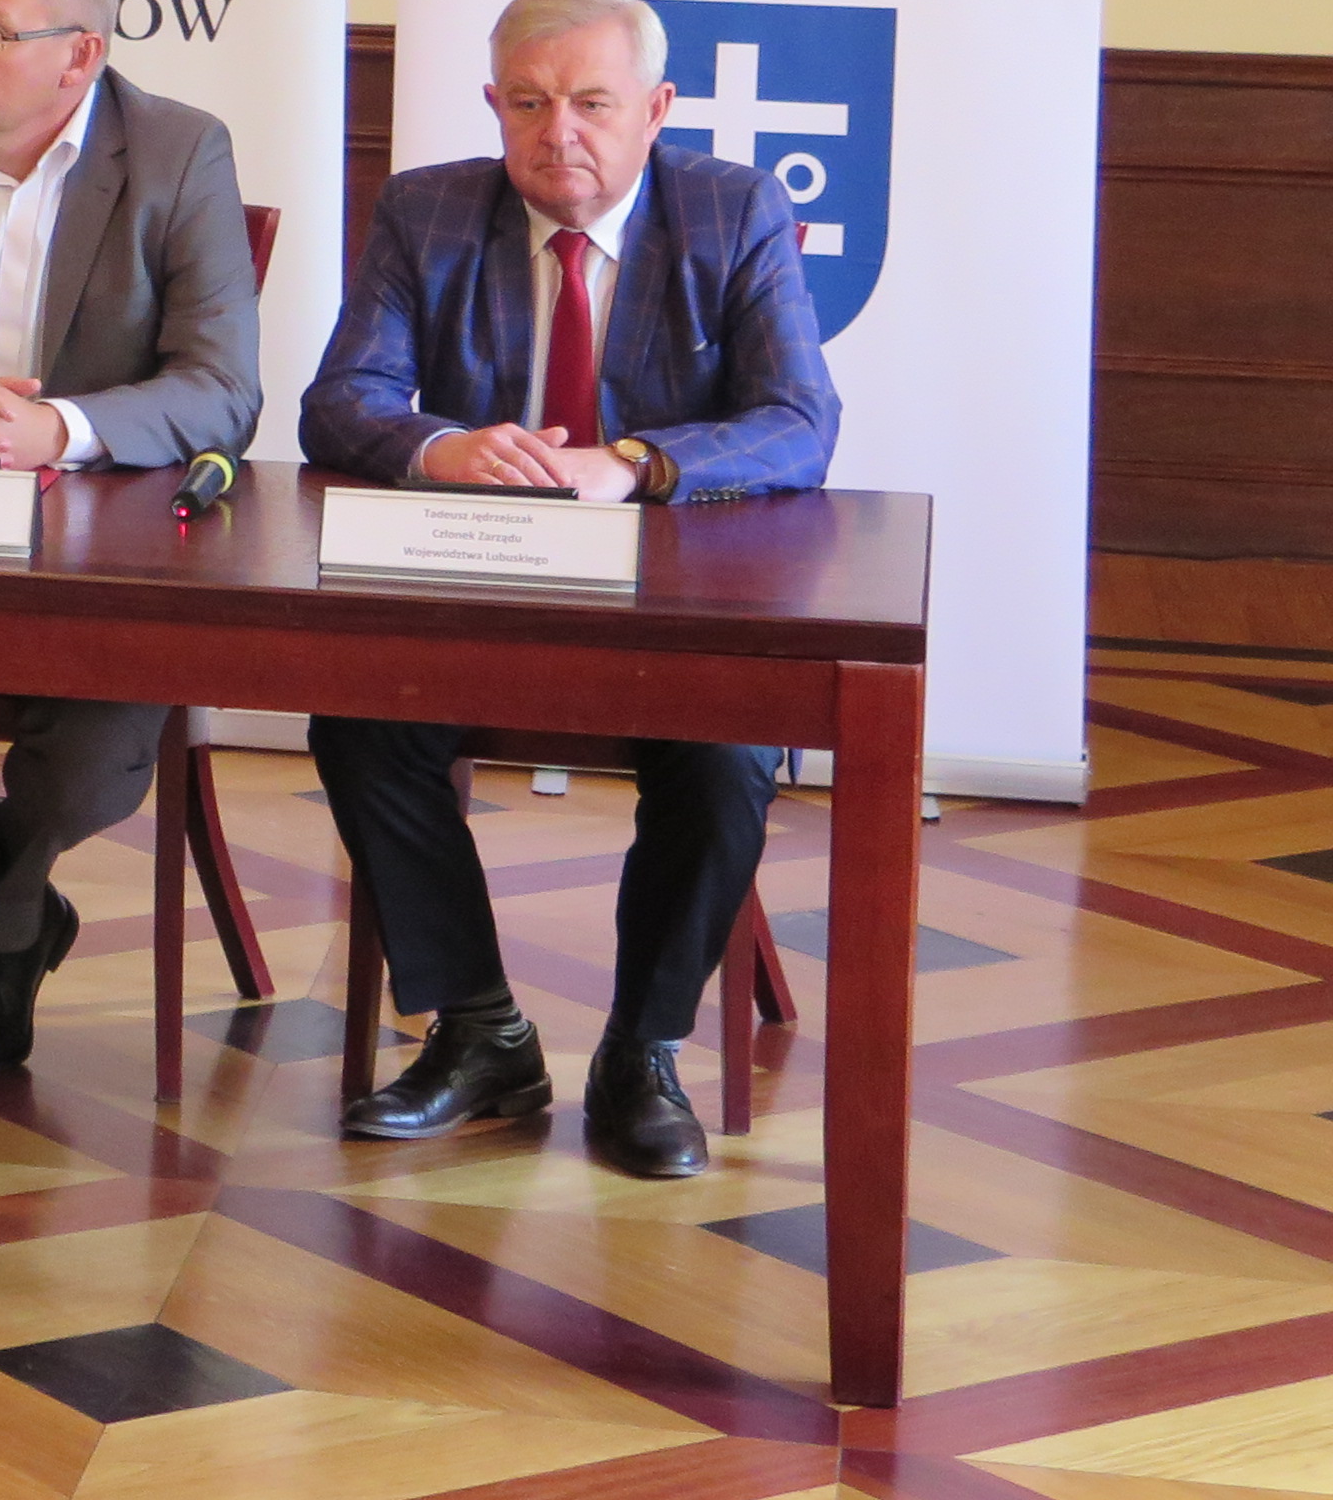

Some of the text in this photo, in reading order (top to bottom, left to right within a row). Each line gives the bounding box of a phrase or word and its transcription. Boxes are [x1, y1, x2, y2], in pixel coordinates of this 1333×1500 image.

[423, 508, 534, 525] Tadeusz Jędrzejczak
[431, 528, 523, 544] Członek Zarządu
[402, 546, 550, 567] Województwa Lubuskiego
